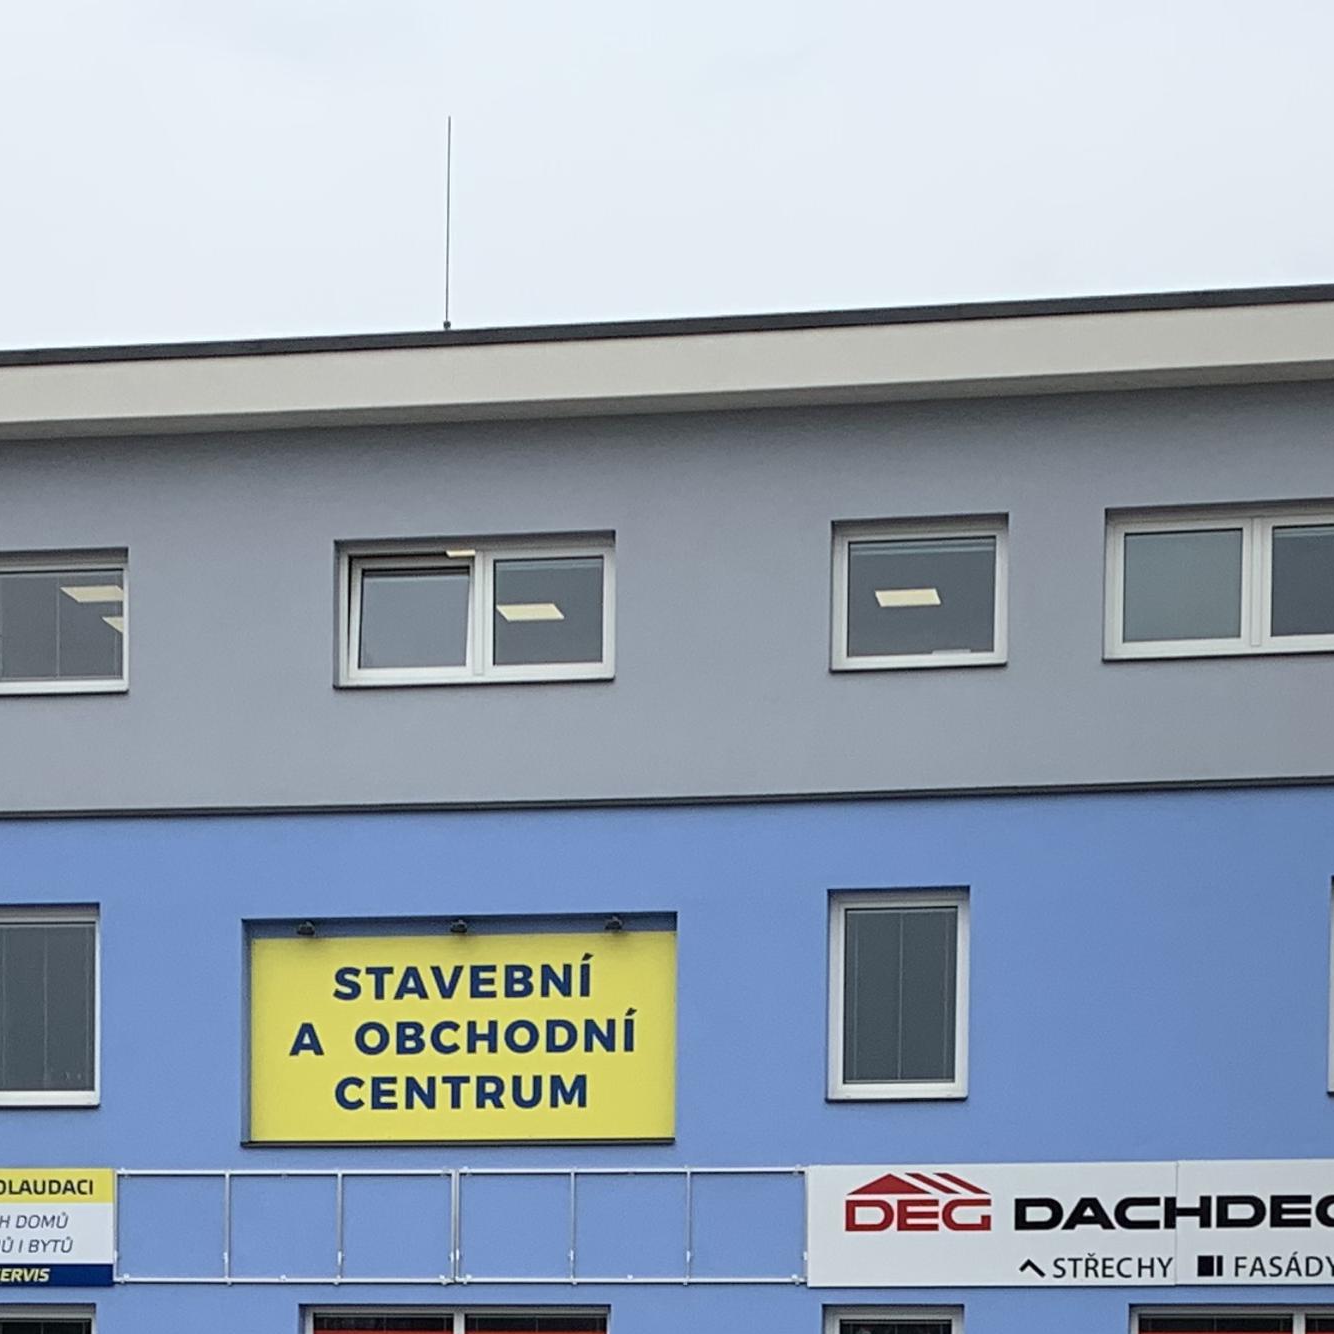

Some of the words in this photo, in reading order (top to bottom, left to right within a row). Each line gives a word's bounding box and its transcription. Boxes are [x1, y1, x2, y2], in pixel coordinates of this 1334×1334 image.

[333, 952, 594, 1001] STAVEBNÍ
[289, 1022, 325, 1056] A
[354, 1007, 637, 1056] OBCHODNÍ
[334, 1074, 588, 1111] CENTRUM
[15, 1211, 69, 1228] DOMŮ
[845, 1199, 992, 1232] DEG
[18, 1239, 23, 1252] I
[28, 1236, 74, 1252] BYTŮ
[1053, 1254, 1173, 1279] STŘECHY
